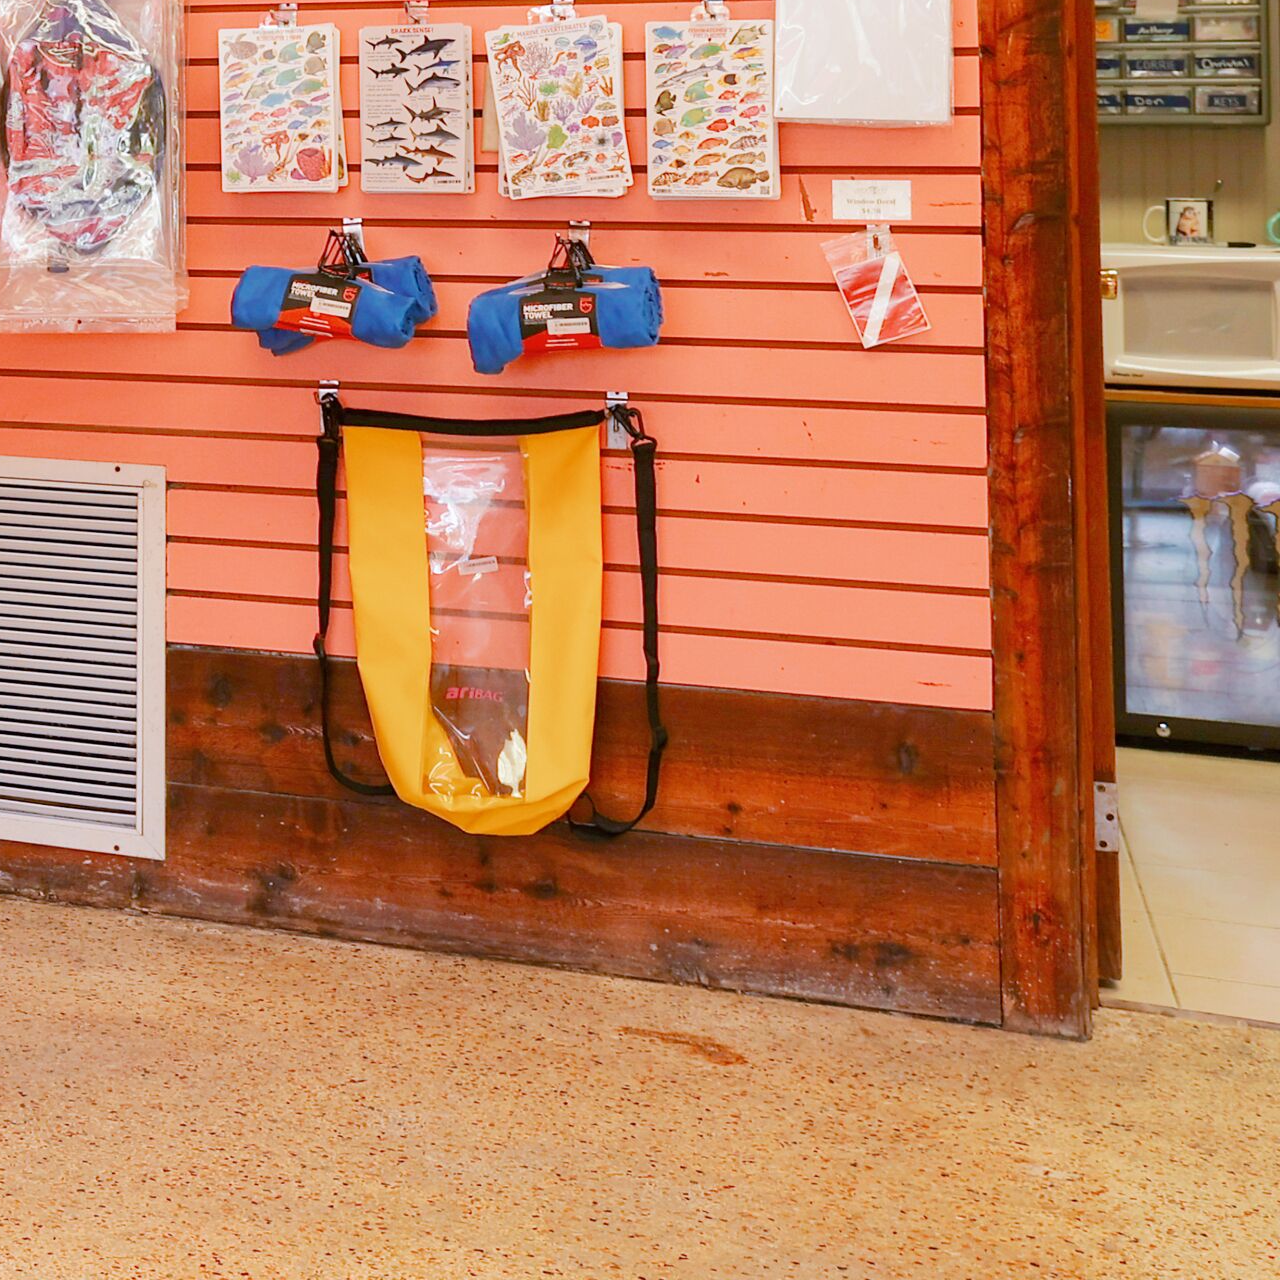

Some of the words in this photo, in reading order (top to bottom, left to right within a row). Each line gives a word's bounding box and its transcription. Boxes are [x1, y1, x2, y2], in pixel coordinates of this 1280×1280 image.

[517, 28, 540, 38] MARINE
[540, 23, 588, 34] INVERTEBRATES
[1213, 96, 1240, 106] KEYS
[290, 281, 339, 297] MICROFIBER
[290, 287, 317, 299] TOWEL
[523, 303, 574, 313] MICROFIBER
[523, 311, 553, 320] TOWEL
